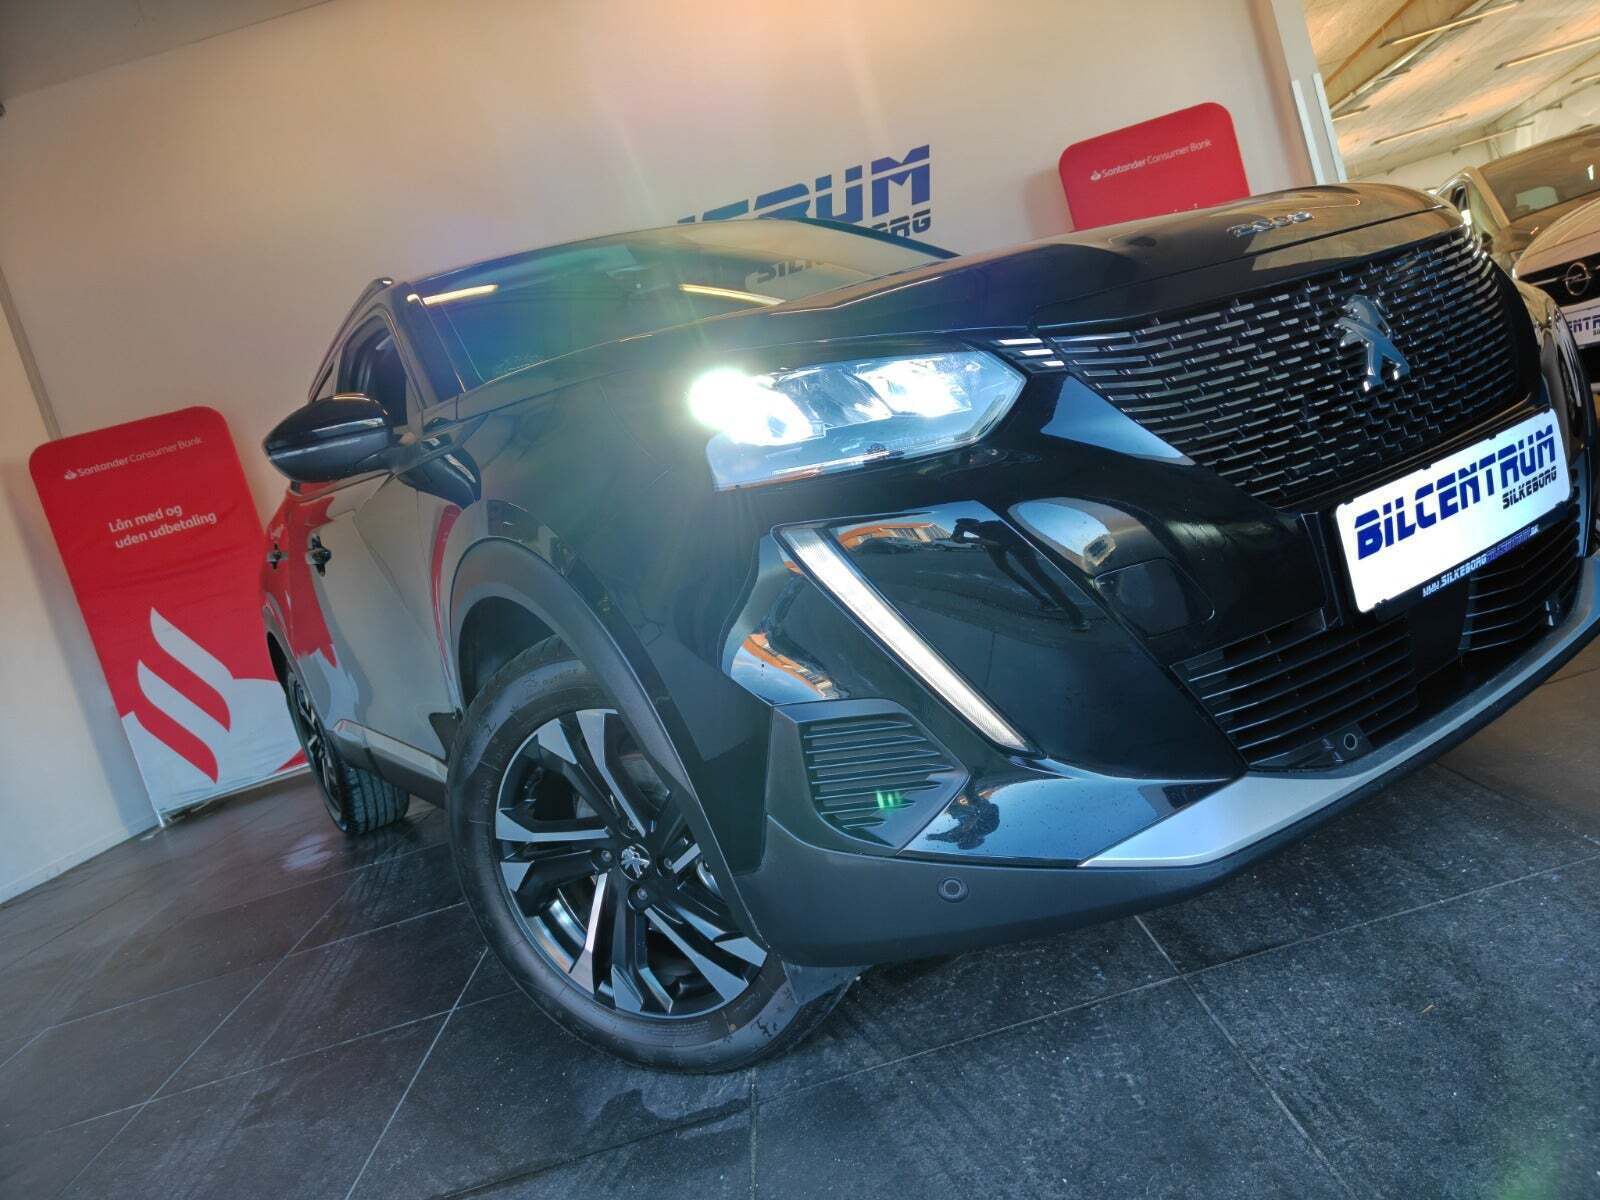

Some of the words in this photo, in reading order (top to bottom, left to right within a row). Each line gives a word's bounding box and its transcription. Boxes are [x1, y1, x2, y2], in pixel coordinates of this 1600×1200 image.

[1102, 159, 1146, 178] Santander
[1147, 145, 1189, 164] Consumer
[1190, 139, 1212, 152] Bank
[78, 457, 129, 477] Santander
[129, 443, 177, 463] Consumer
[177, 436, 203, 450] Bank
[1354, 424, 1556, 560] BILCENTRUM
[1502, 466, 1557, 510] SILKEBORG
[108, 518, 134, 533] Lån
[135, 507, 164, 526] med
[165, 505, 183, 517] og
[115, 534, 148, 548] uden
[149, 512, 217, 538] udbetaling
